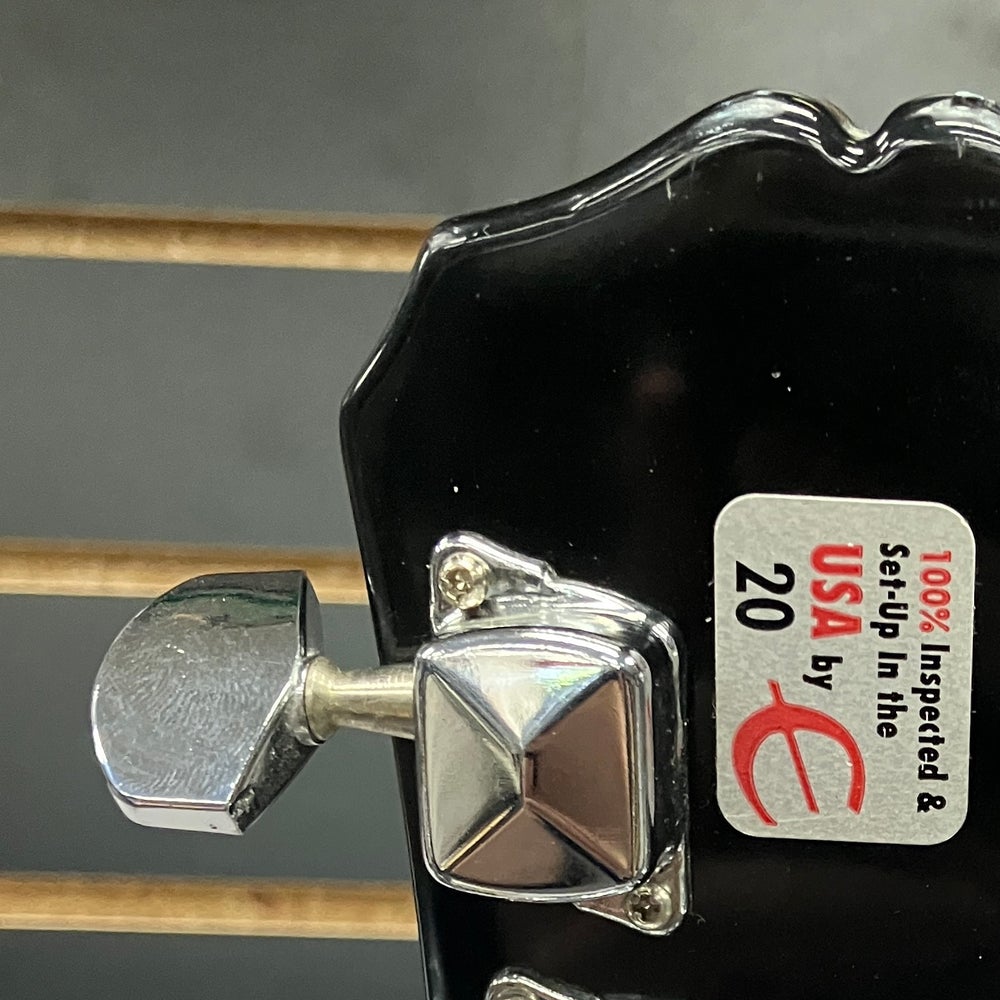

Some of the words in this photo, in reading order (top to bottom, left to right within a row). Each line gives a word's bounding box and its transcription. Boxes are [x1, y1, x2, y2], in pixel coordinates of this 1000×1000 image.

[735, 560, 796, 632] 20
[810, 543, 864, 640] USA
[870, 543, 911, 639] Set-Up
[918, 550, 952, 634] 100%
[802, 655, 844, 691] by
[876, 651, 908, 679] In
[876, 691, 909, 739] the
[911, 643, 951, 782] Inspected
[917, 791, 948, 813] &
